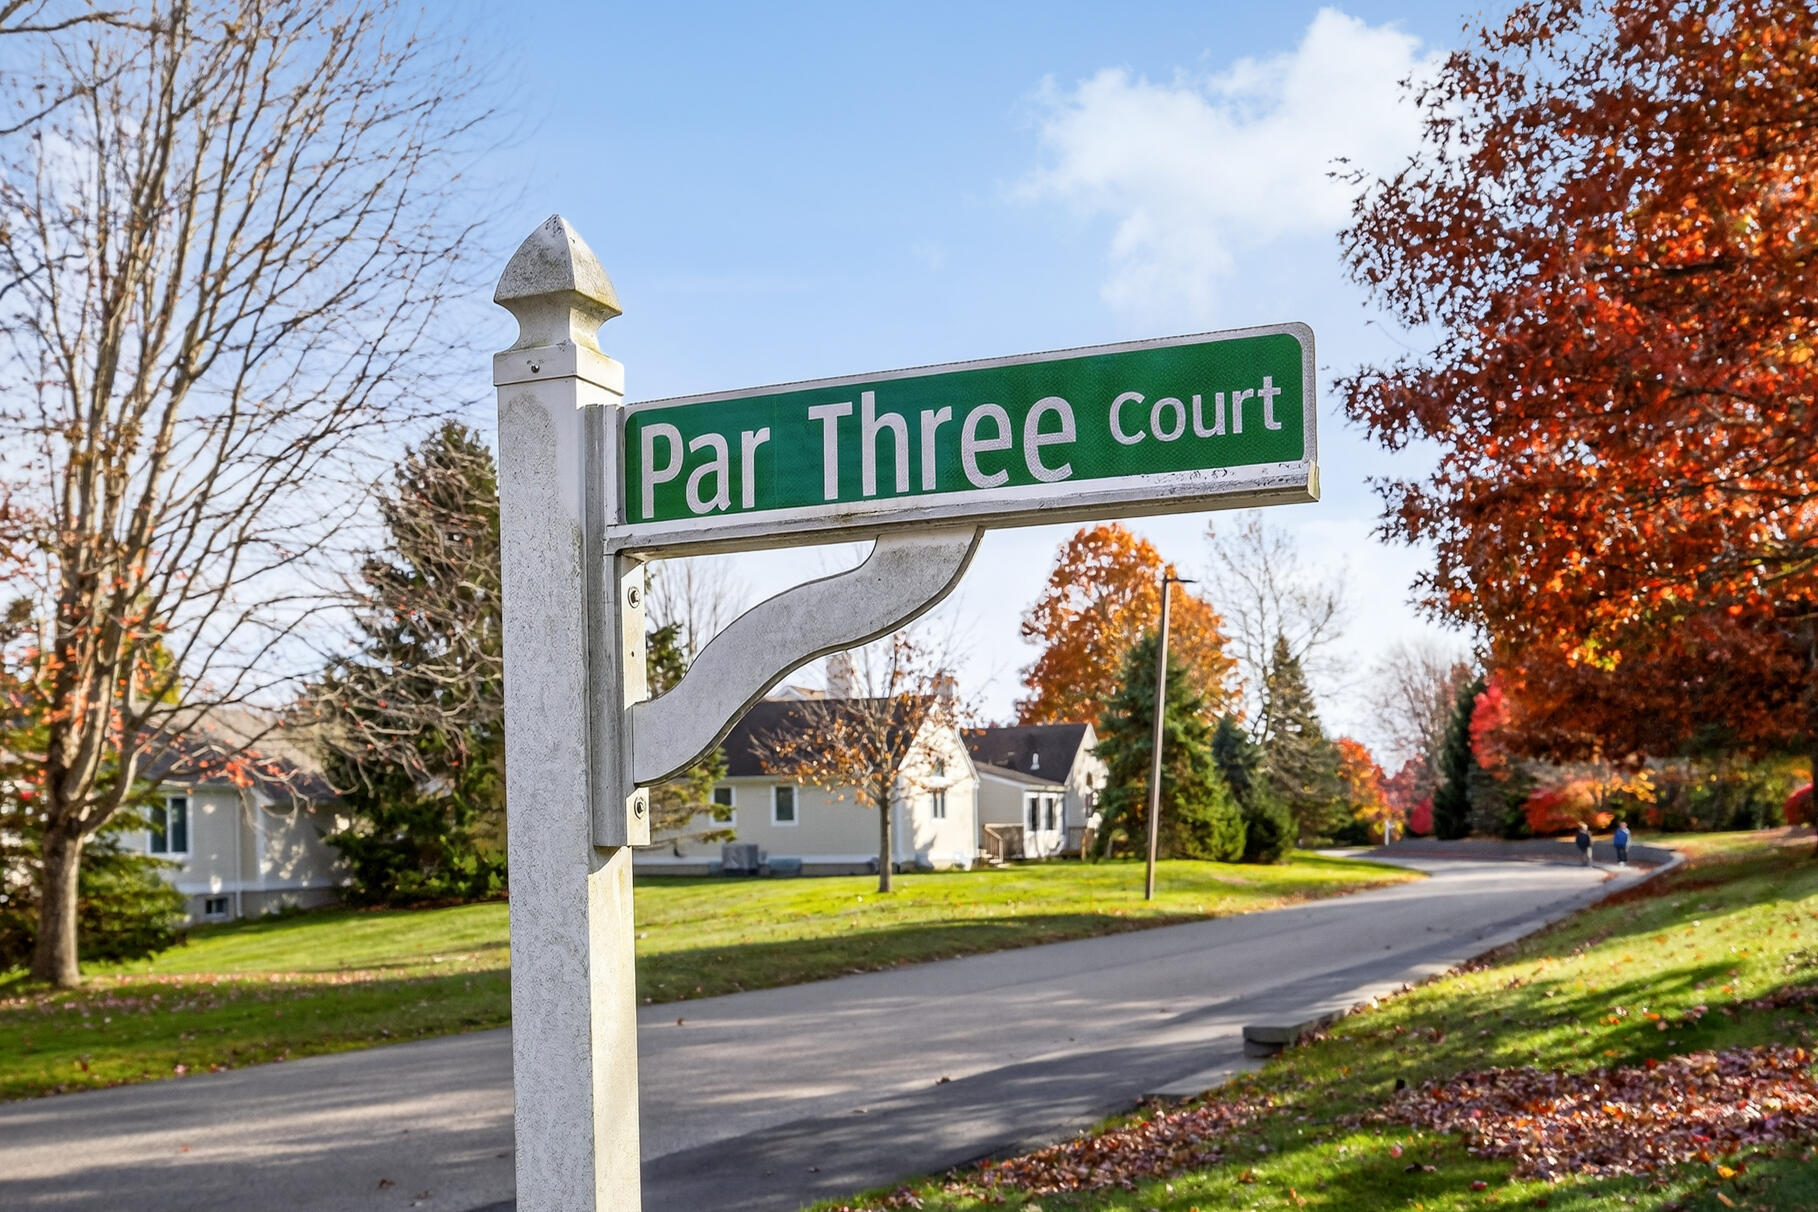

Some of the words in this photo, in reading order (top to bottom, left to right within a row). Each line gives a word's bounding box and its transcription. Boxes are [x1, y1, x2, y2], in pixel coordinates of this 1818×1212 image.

[640, 422, 772, 520] Par
[807, 390, 1078, 501] Three
[1109, 375, 1283, 446] Court
